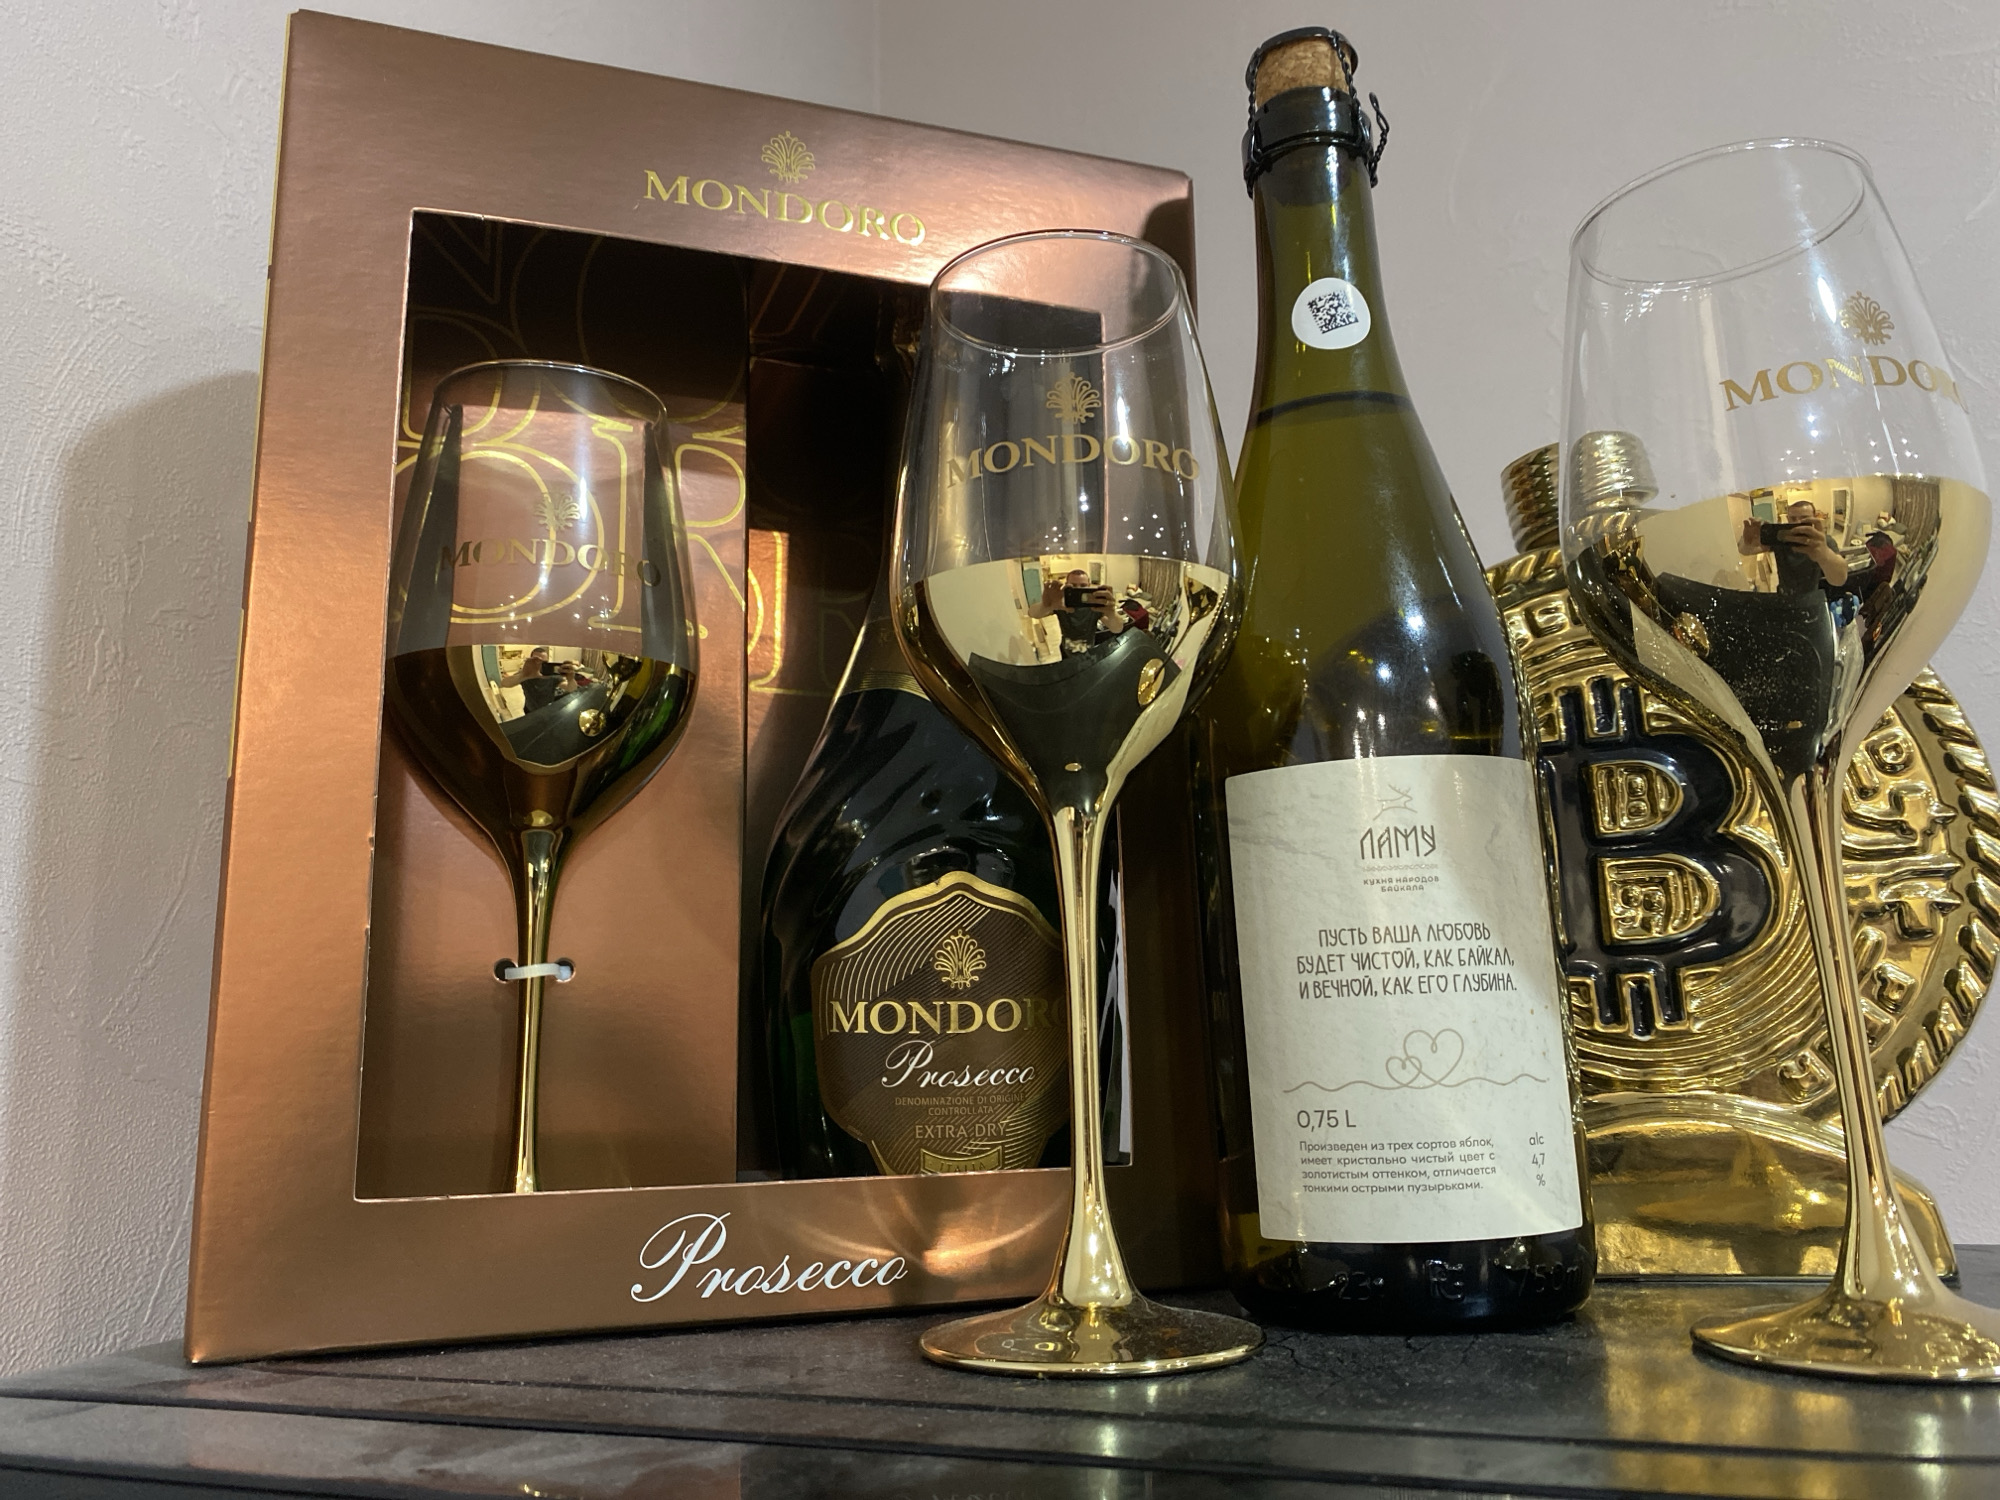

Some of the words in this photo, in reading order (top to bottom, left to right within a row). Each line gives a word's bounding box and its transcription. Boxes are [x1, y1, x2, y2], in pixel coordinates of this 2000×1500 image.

[644, 169, 926, 246] MONDORO
[1719, 355, 1969, 414] MONDO
[946, 434, 1199, 488] MONDORO
[441, 538, 661, 587] MONDORO
[1360, 825, 1436, 860] ЛАМУ
[1396, 875, 1440, 884] НАРОДОВ
[1319, 928, 1367, 947] ПУСТЬ
[1372, 925, 1421, 944] ВАША
[1427, 922, 1491, 942] ЛЮБОВЬ
[1297, 954, 1345, 975] БУДЕТ
[1351, 947, 1420, 970] ЧИСТОЙ,
[1424, 949, 1454, 968] КАК
[1458, 945, 1515, 967] БАЙКАЛ,
[1299, 981, 1309, 999] И
[1313, 975, 1378, 999] ВЕЧНОЙ,
[1382, 976, 1413, 996] КАК
[1418, 974, 1448, 994] ЕГО
[1453, 973, 1517, 993] ГЛУБИНА.
[881, 1040, 1036, 1088] Prosecco
[895, 1096, 974, 1106] DENOMINAZIONE
[977, 1095, 987, 1104] DI
[928, 1105, 994, 1116] CONTROLLATA
[915, 1124, 968, 1139] EXTRA
[975, 1122, 1006, 1137] DRY
[1297, 1109, 1339, 1132] 0,75
[1346, 1109, 1356, 1128] L
[1299, 1140, 1368, 1153] Произведен
[1370, 1143, 1385, 1151] из
[1387, 1142, 1414, 1153] трех
[1416, 1140, 1457, 1152] сортов
[1459, 1137, 1494, 1148] яблок,
[1529, 1132, 1544, 1147] alc
[1301, 1157, 1332, 1166] имеет
[1337, 1155, 1407, 1167] кристально
[1411, 1151, 1454, 1164] чистый
[1459, 1153, 1485, 1164] цвет
[1489, 1152, 1495, 1161] с
[1531, 1153, 1546, 1168] 4,7
[1302, 1170, 1369, 1179] золотистым
[1372, 1169, 1430, 1180] оттенком,
[1433, 1166, 1496, 1177] отличается
[1536, 1174, 1546, 1187] %
[1303, 1184, 1349, 1193] тонкими
[1351, 1183, 1405, 1195] острыми
[1407, 1181, 1484, 1194] пузырьками.
[631, 1212, 908, 1302] Prosecco
